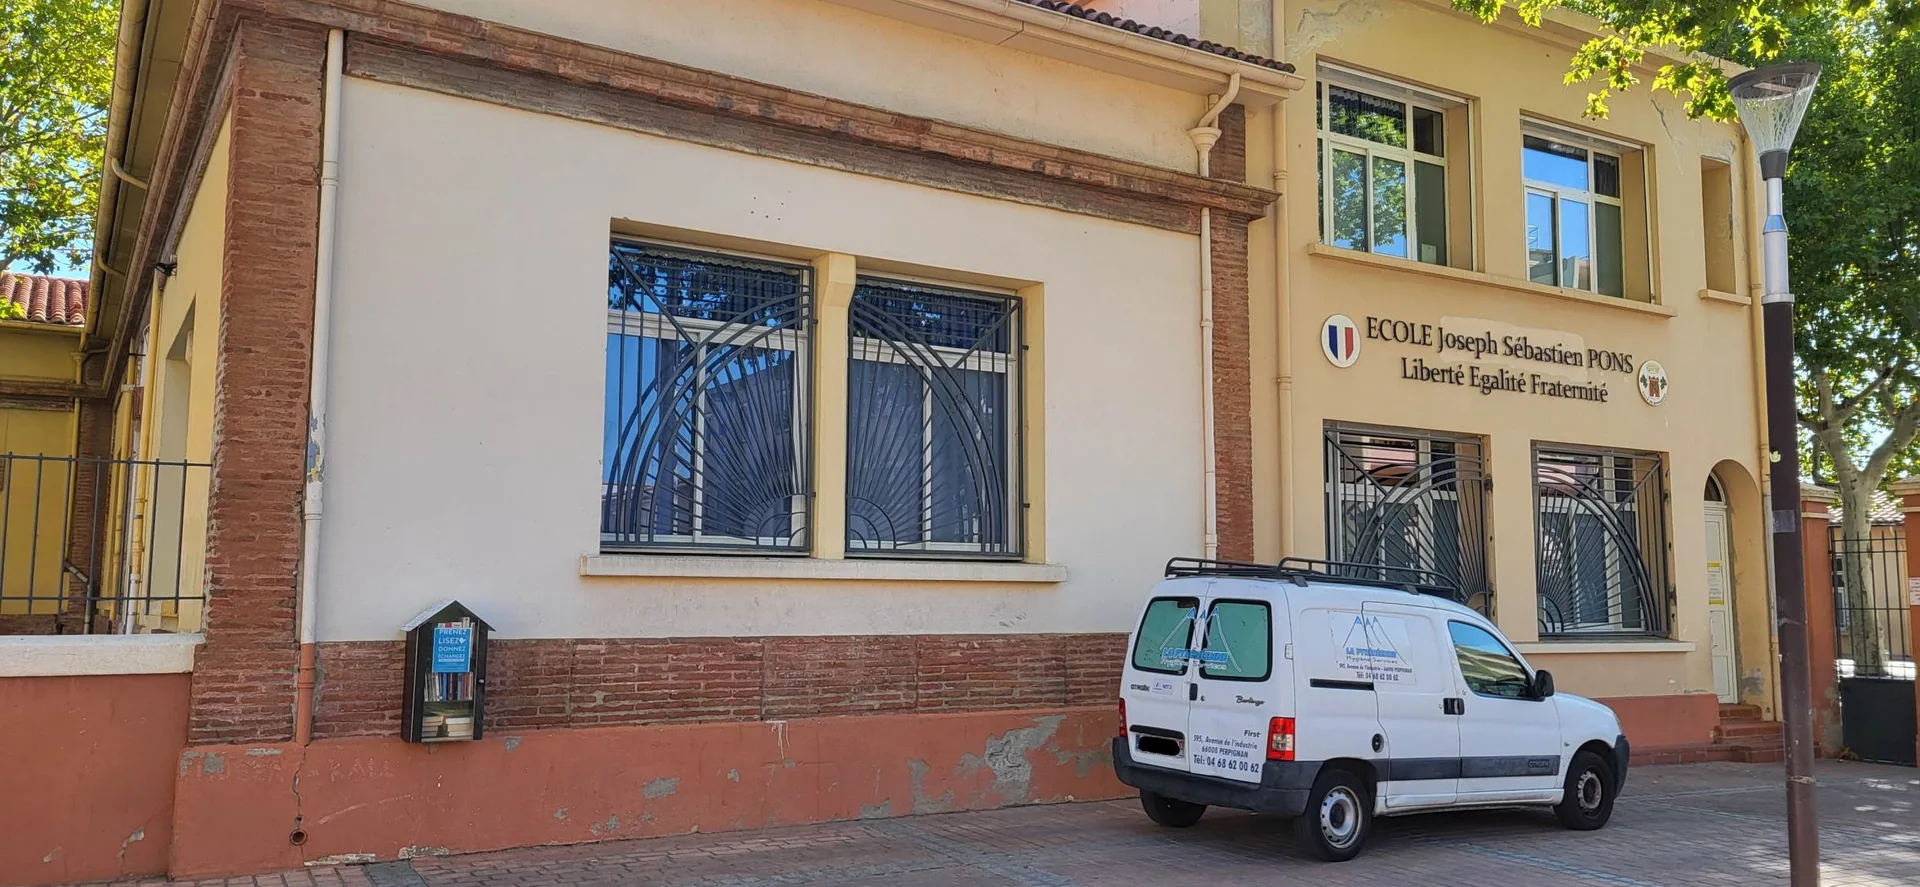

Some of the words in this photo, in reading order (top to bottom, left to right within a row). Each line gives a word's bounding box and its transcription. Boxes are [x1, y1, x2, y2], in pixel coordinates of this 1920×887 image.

[1366, 316, 1432, 347] ECOLE
[1438, 327, 1498, 360] Joseph
[1503, 335, 1584, 367] Sébastien
[1588, 349, 1634, 374] PONS
[1401, 357, 1465, 386] Liberté
[1470, 366, 1527, 396] Egalité
[1530, 374, 1608, 403] Fraternité
[1236, 695, 1264, 706] Berlingo
[1193, 734, 1204, 744] 595,
[1205, 736, 1223, 745] Avenue
[1202, 745, 1218, 754] 66000
[1219, 748, 1248, 758] PERPIGNAN
[1207, 756, 1215, 766] 04
[1217, 758, 1226, 768] 68
[1228, 760, 1237, 770] 62
[1239, 761, 1248, 771] 00
[1250, 763, 1259, 773] 62
